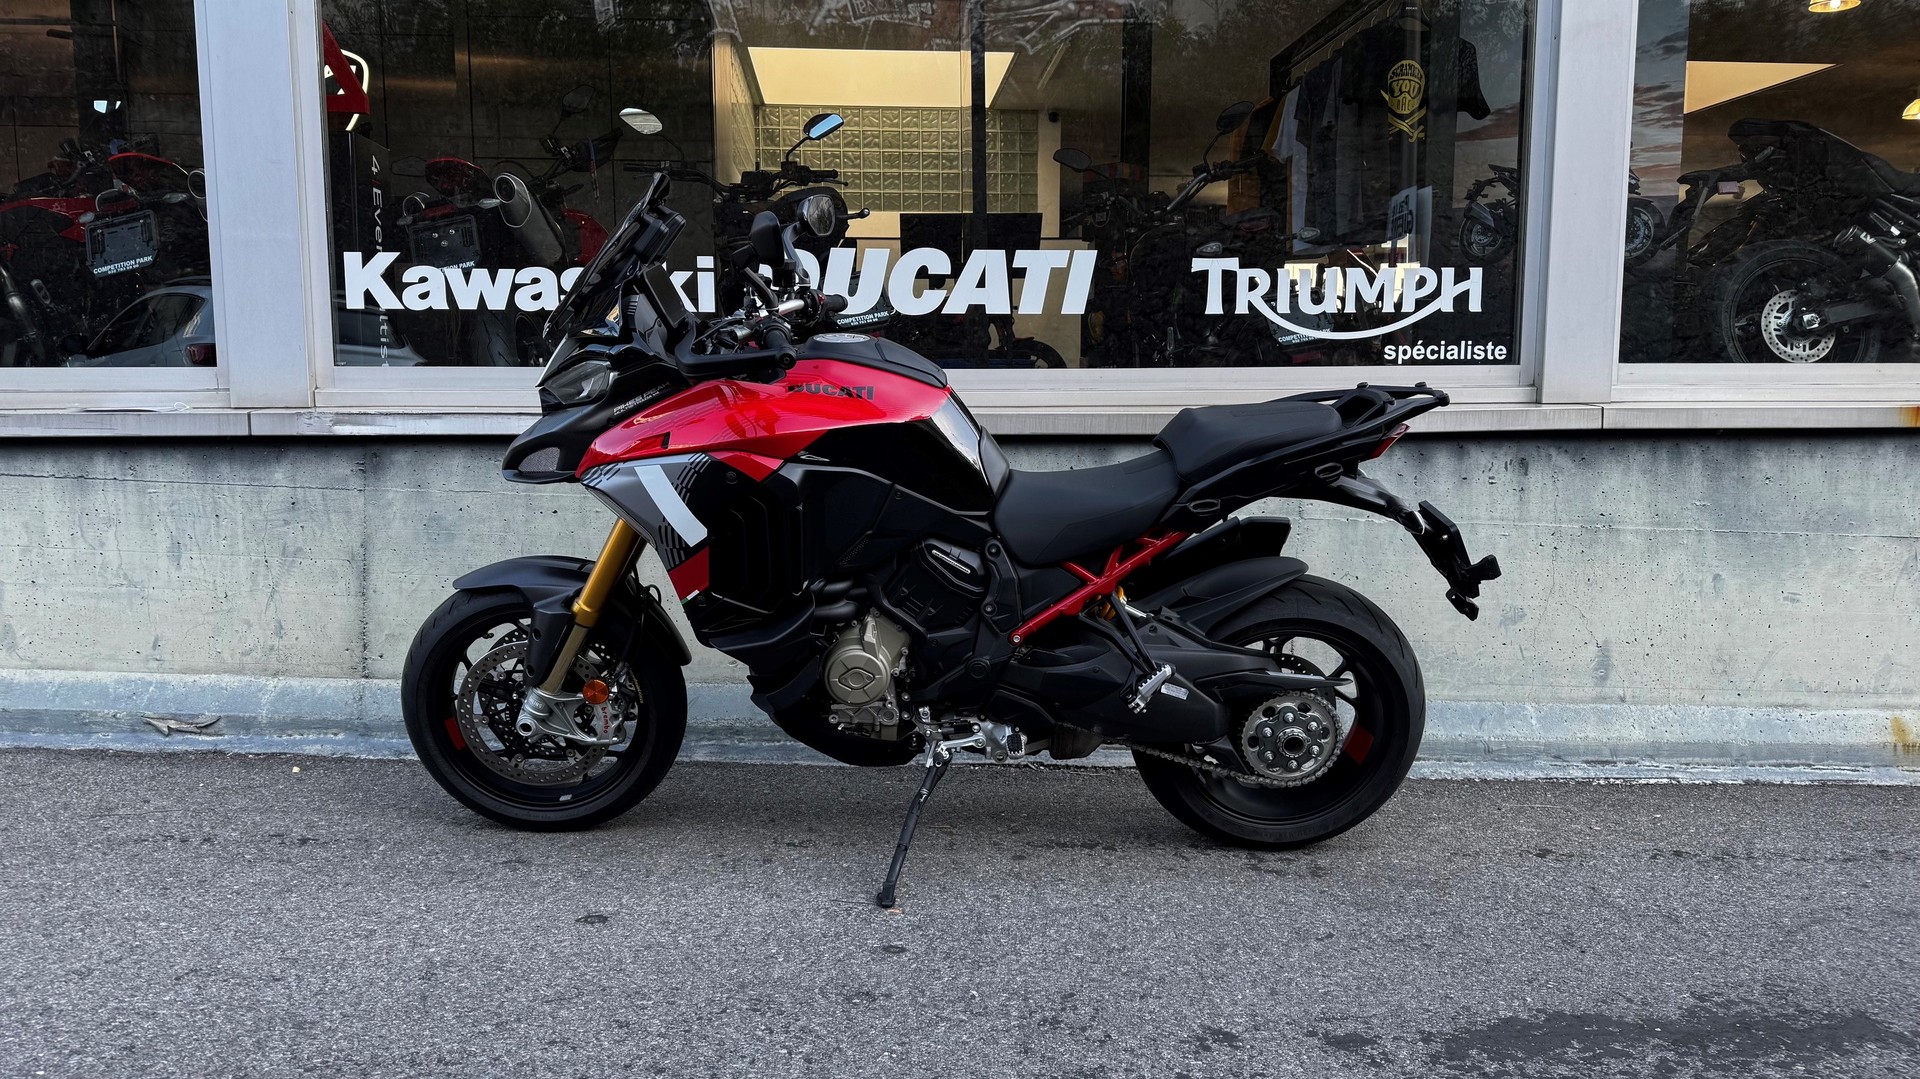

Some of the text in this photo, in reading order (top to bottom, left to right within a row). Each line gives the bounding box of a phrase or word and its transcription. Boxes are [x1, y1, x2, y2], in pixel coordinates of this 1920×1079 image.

[93, 260, 135, 274] COMPETITION
[136, 255, 153, 264] PARK
[343, 251, 716, 313] Kawaki
[1191, 257, 1483, 339] TRIUMPH
[837, 313, 874, 325] COMPETITION
[874, 311, 890, 319] PARK
[1383, 340, 1507, 364] spécialiste
[788, 383, 874, 401] DUCATI
[601, 706, 610, 734] brembo
